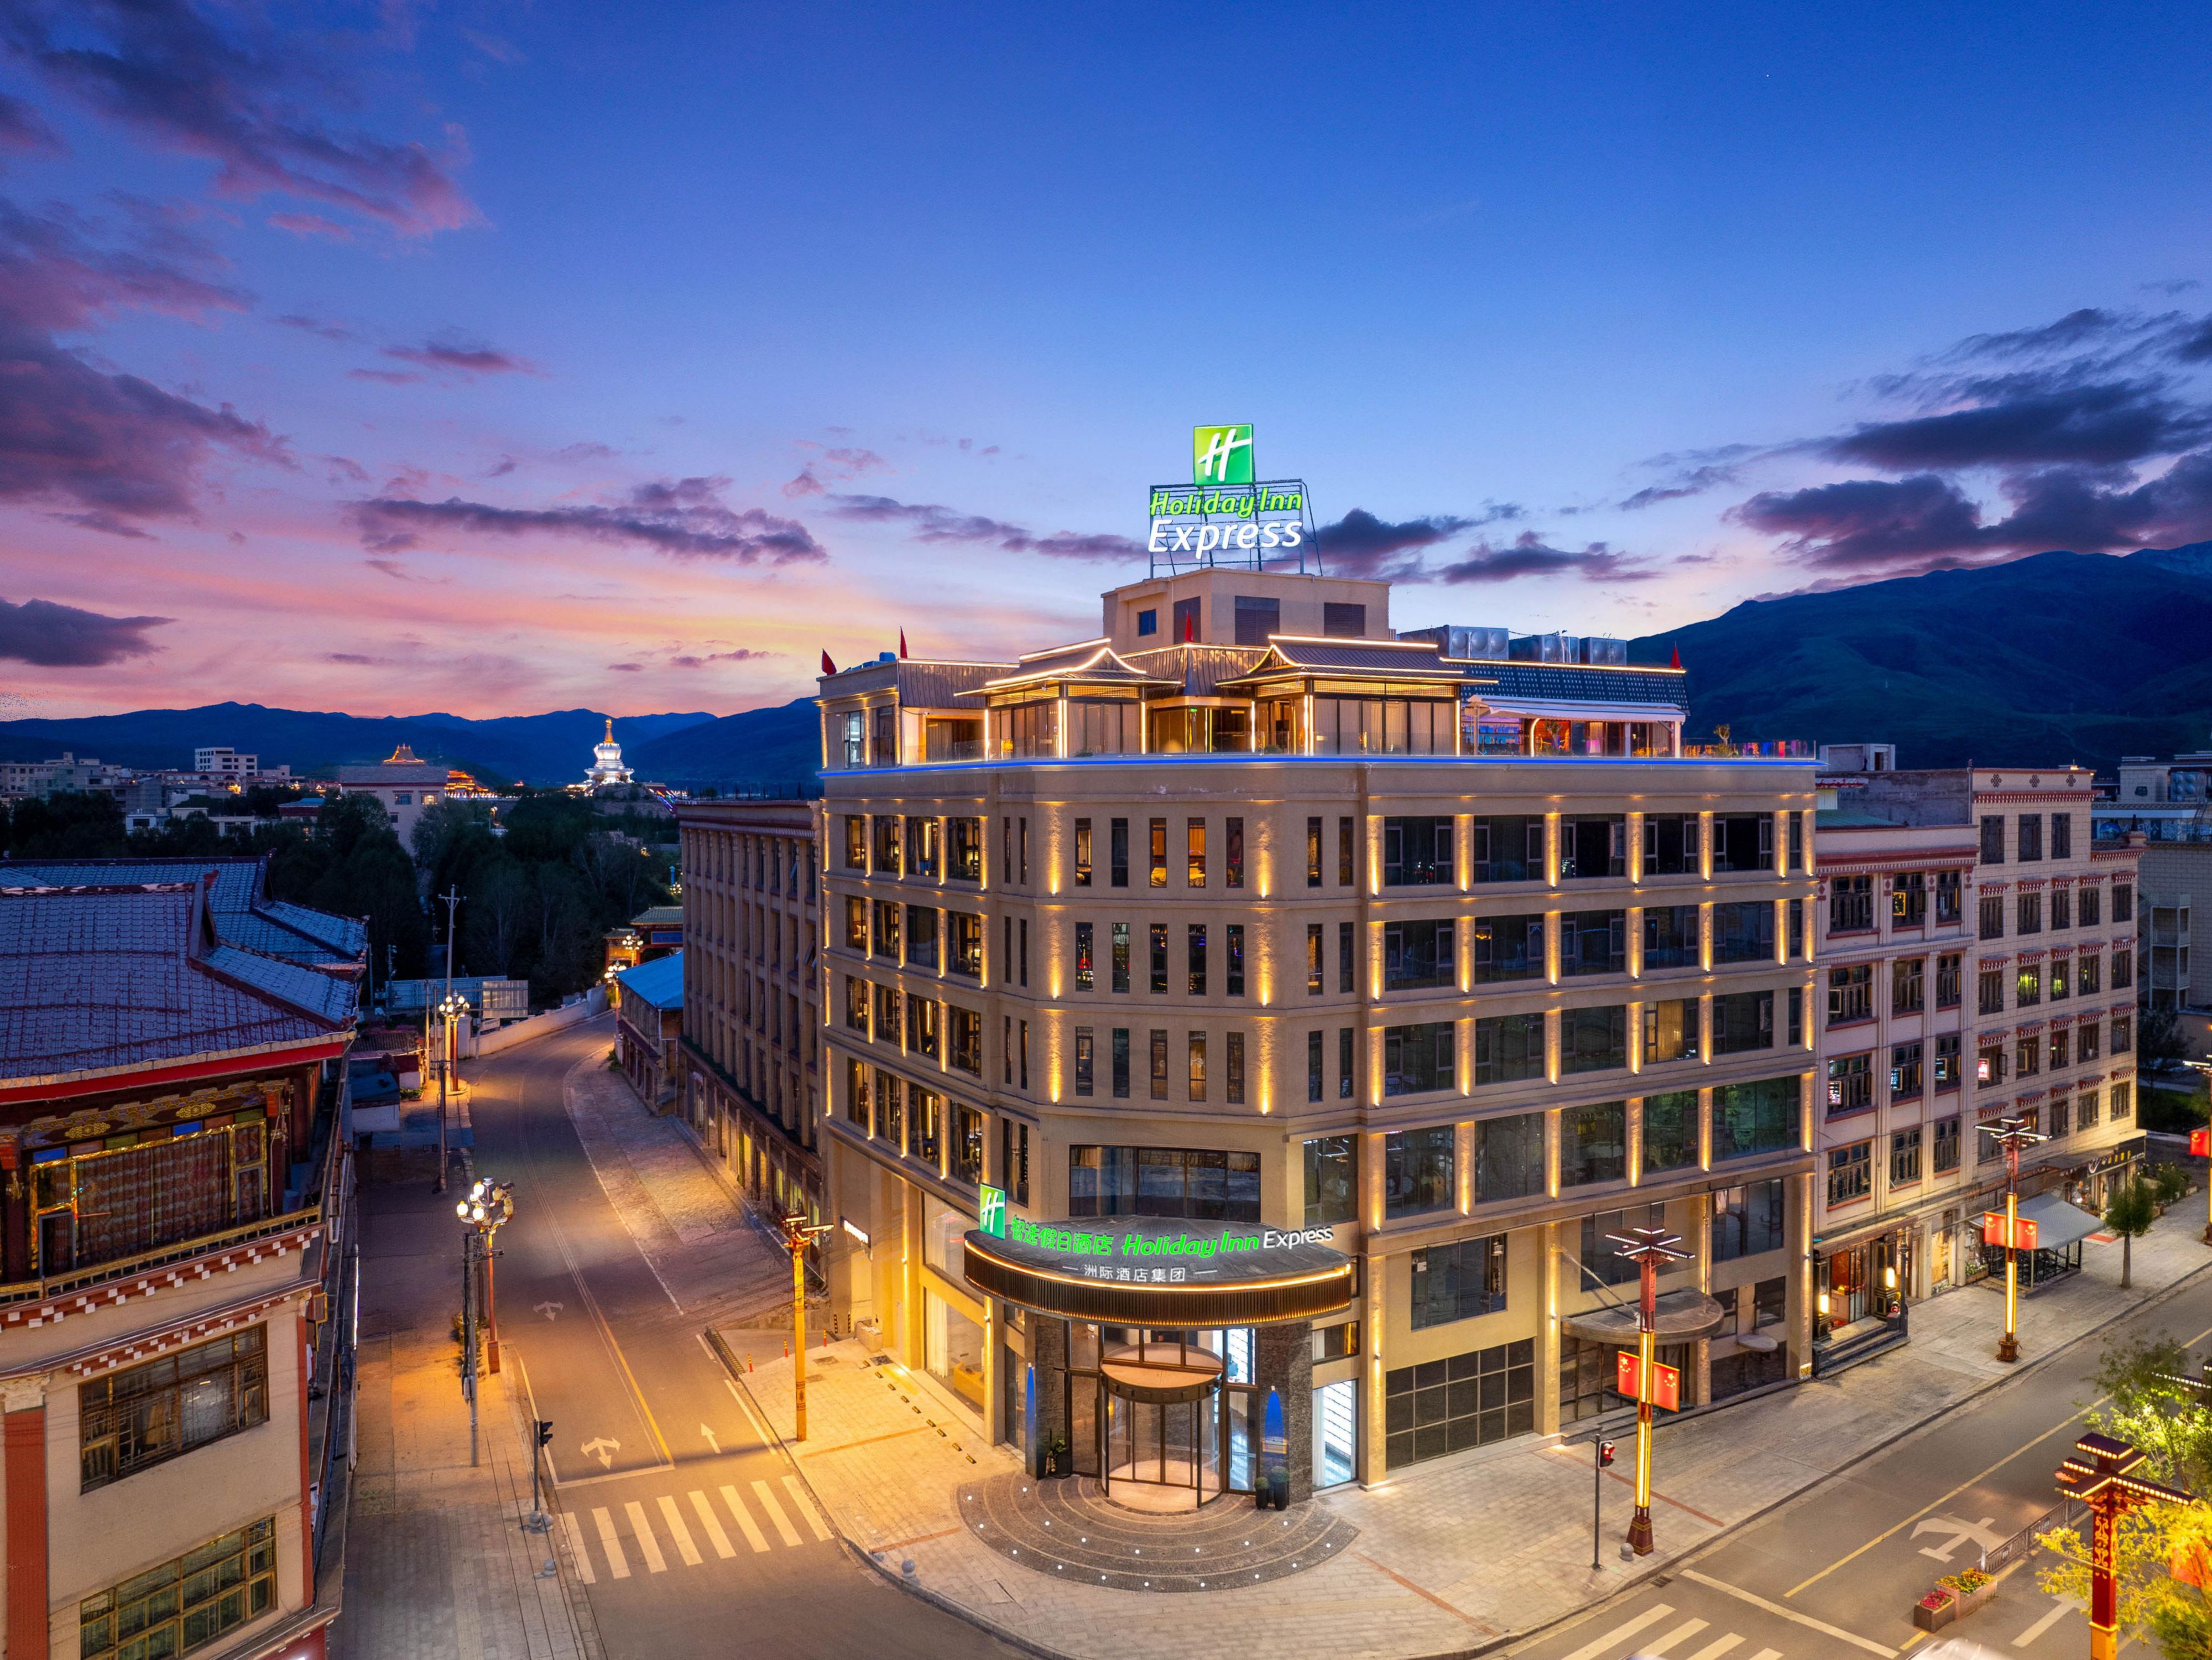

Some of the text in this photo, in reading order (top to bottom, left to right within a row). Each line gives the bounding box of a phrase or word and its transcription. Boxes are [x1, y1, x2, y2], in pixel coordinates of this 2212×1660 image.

[1198, 428, 1253, 481] H
[1150, 487, 1302, 518] Holiday Inn
[1148, 519, 1302, 559] Express
[982, 1191, 1005, 1233] H
[1010, 1217, 1114, 1256] 智选假日酒店
[1121, 1229, 1333, 1258] Holiday Inn Express
[1084, 1264, 1186, 1282] 洲际酒店集团
